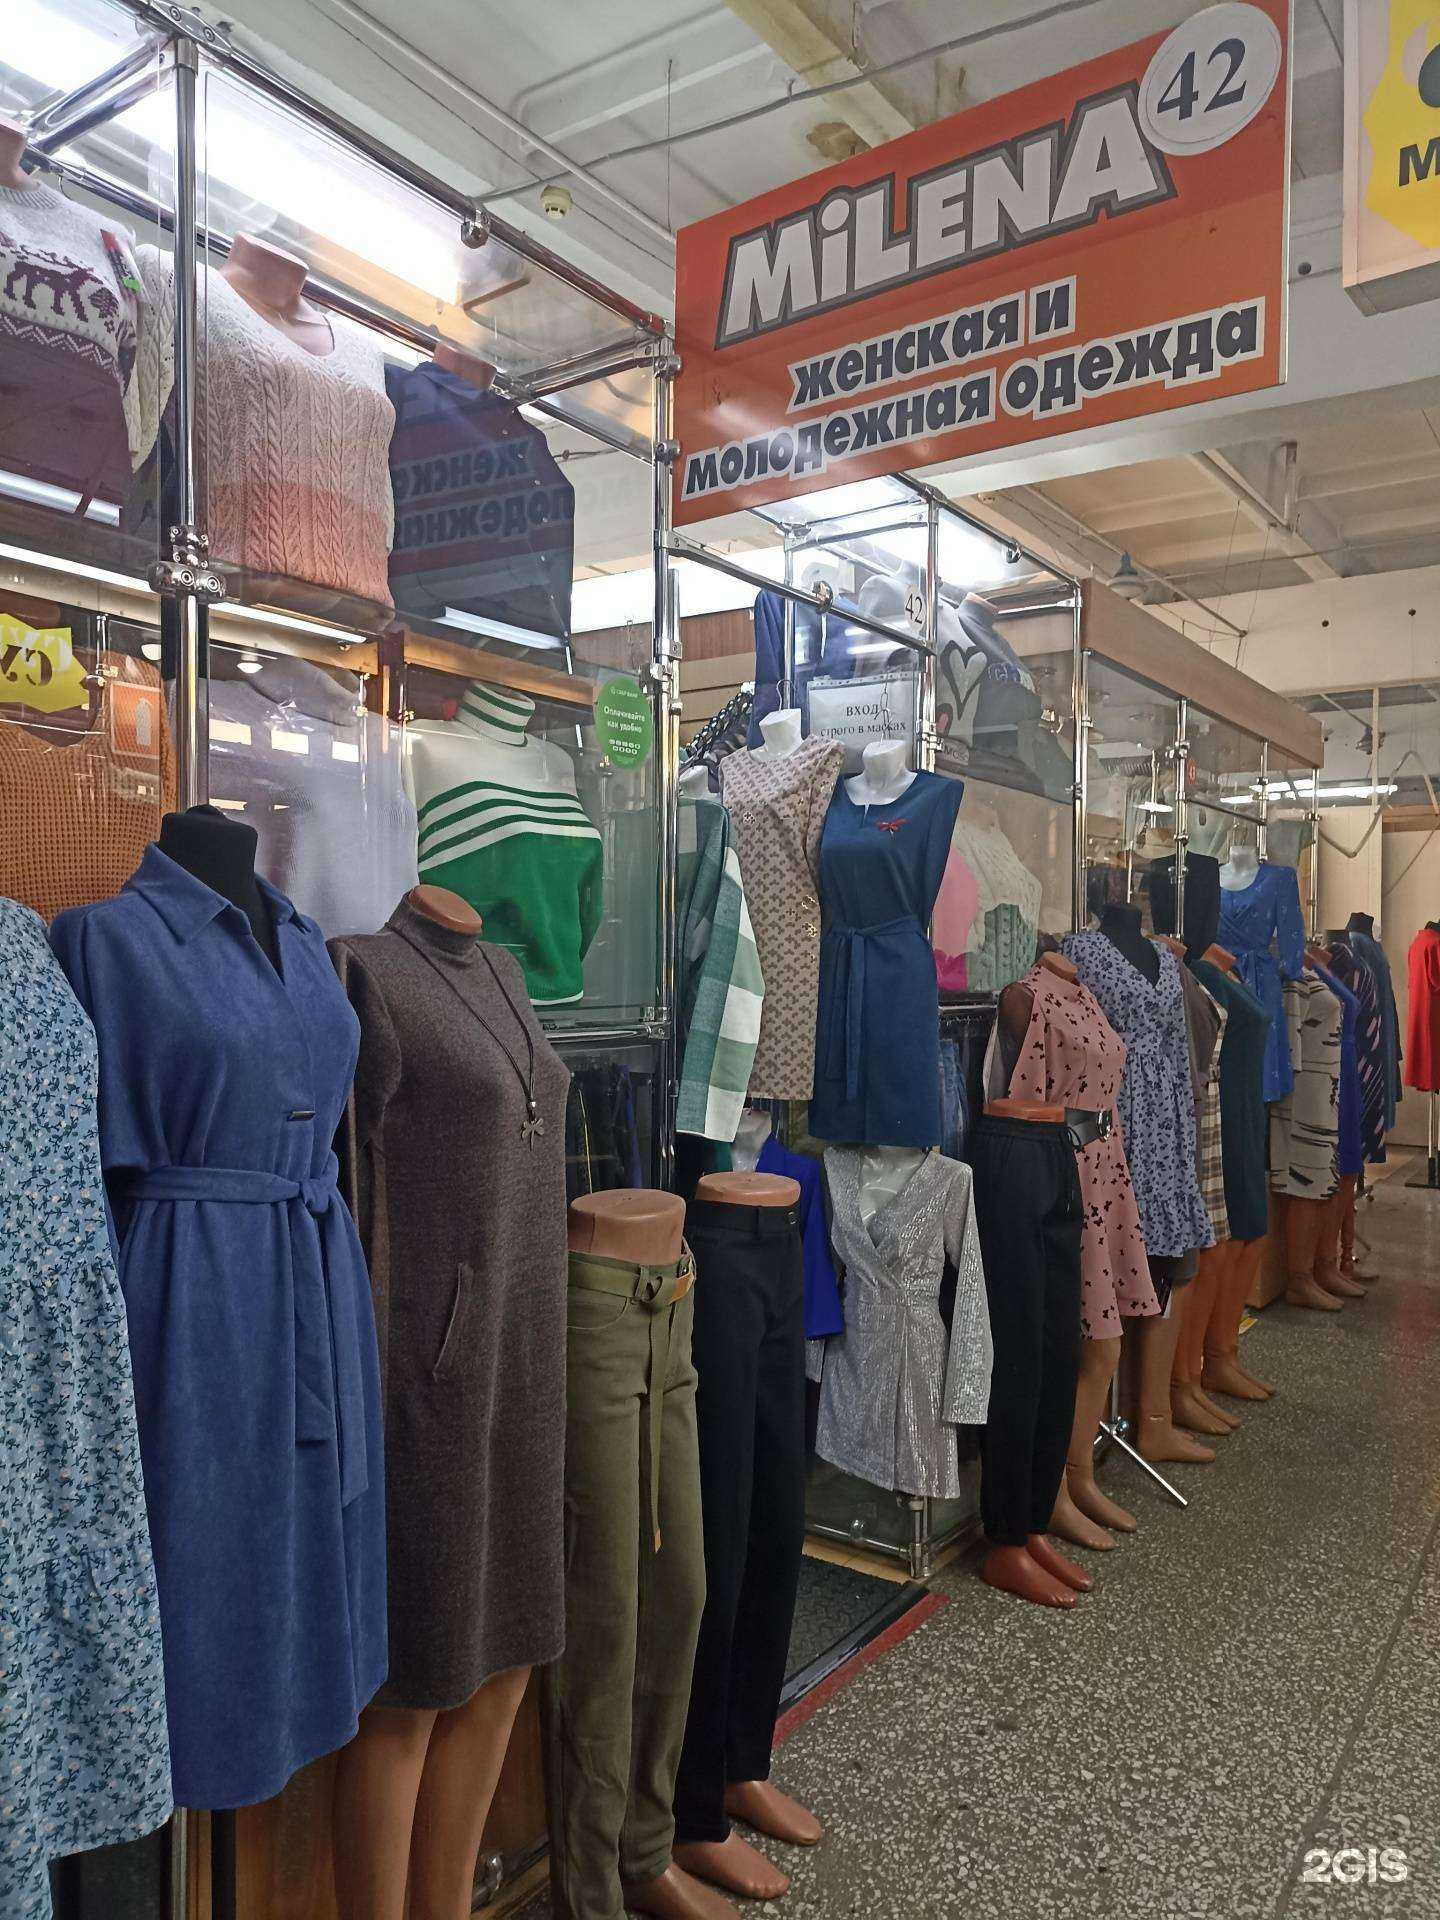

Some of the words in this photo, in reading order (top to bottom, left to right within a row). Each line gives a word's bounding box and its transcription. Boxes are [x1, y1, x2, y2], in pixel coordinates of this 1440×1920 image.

[1156, 37, 1249, 122] 42
[793, 299, 1019, 406] женская
[1036, 285, 1070, 336] и
[685, 375, 991, 495] молодежная
[1005, 305, 1258, 412] одежда
[905, 592, 923, 625] 42
[846, 704, 879, 717] ВХОД
[620, 721, 643, 734] удобно
[820, 725, 855, 738] строго
[867, 721, 907, 734] масках
